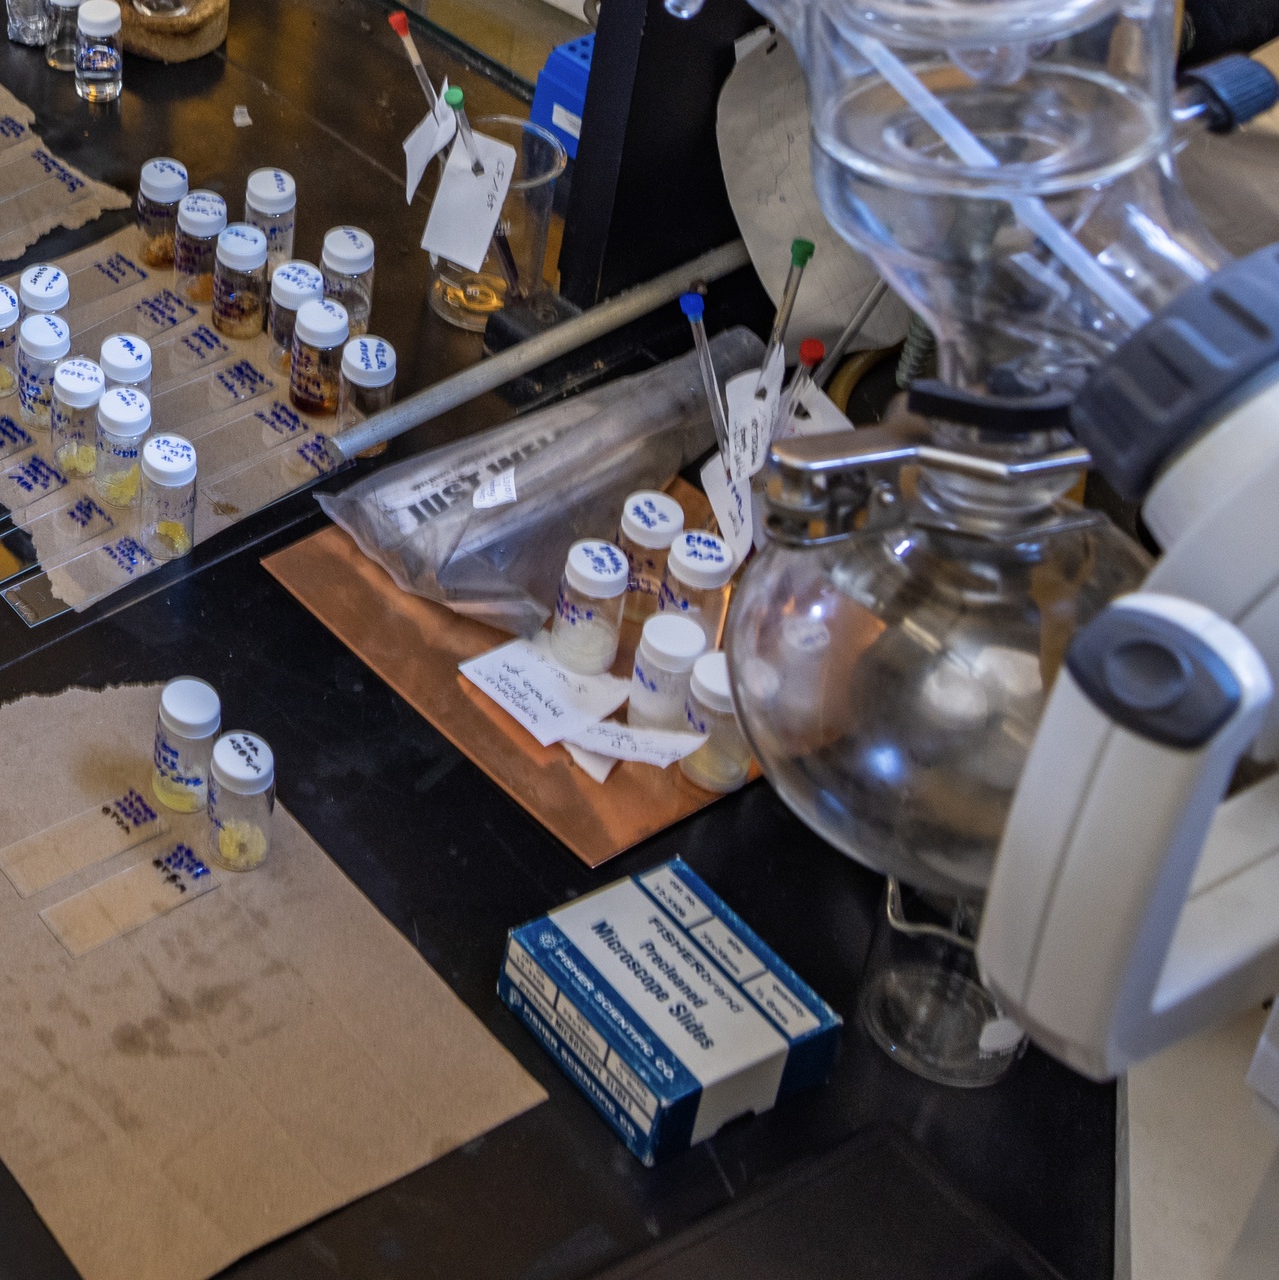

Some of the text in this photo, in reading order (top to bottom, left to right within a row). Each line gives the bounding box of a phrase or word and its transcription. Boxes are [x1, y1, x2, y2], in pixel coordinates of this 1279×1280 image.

[555, 948, 596, 992] FISHER
[593, 990, 655, 1060] SCIENTIFIC
[591, 918, 671, 1005] Microscope
[668, 999, 715, 1052] Slides
[640, 939, 710, 1010] Precleaned
